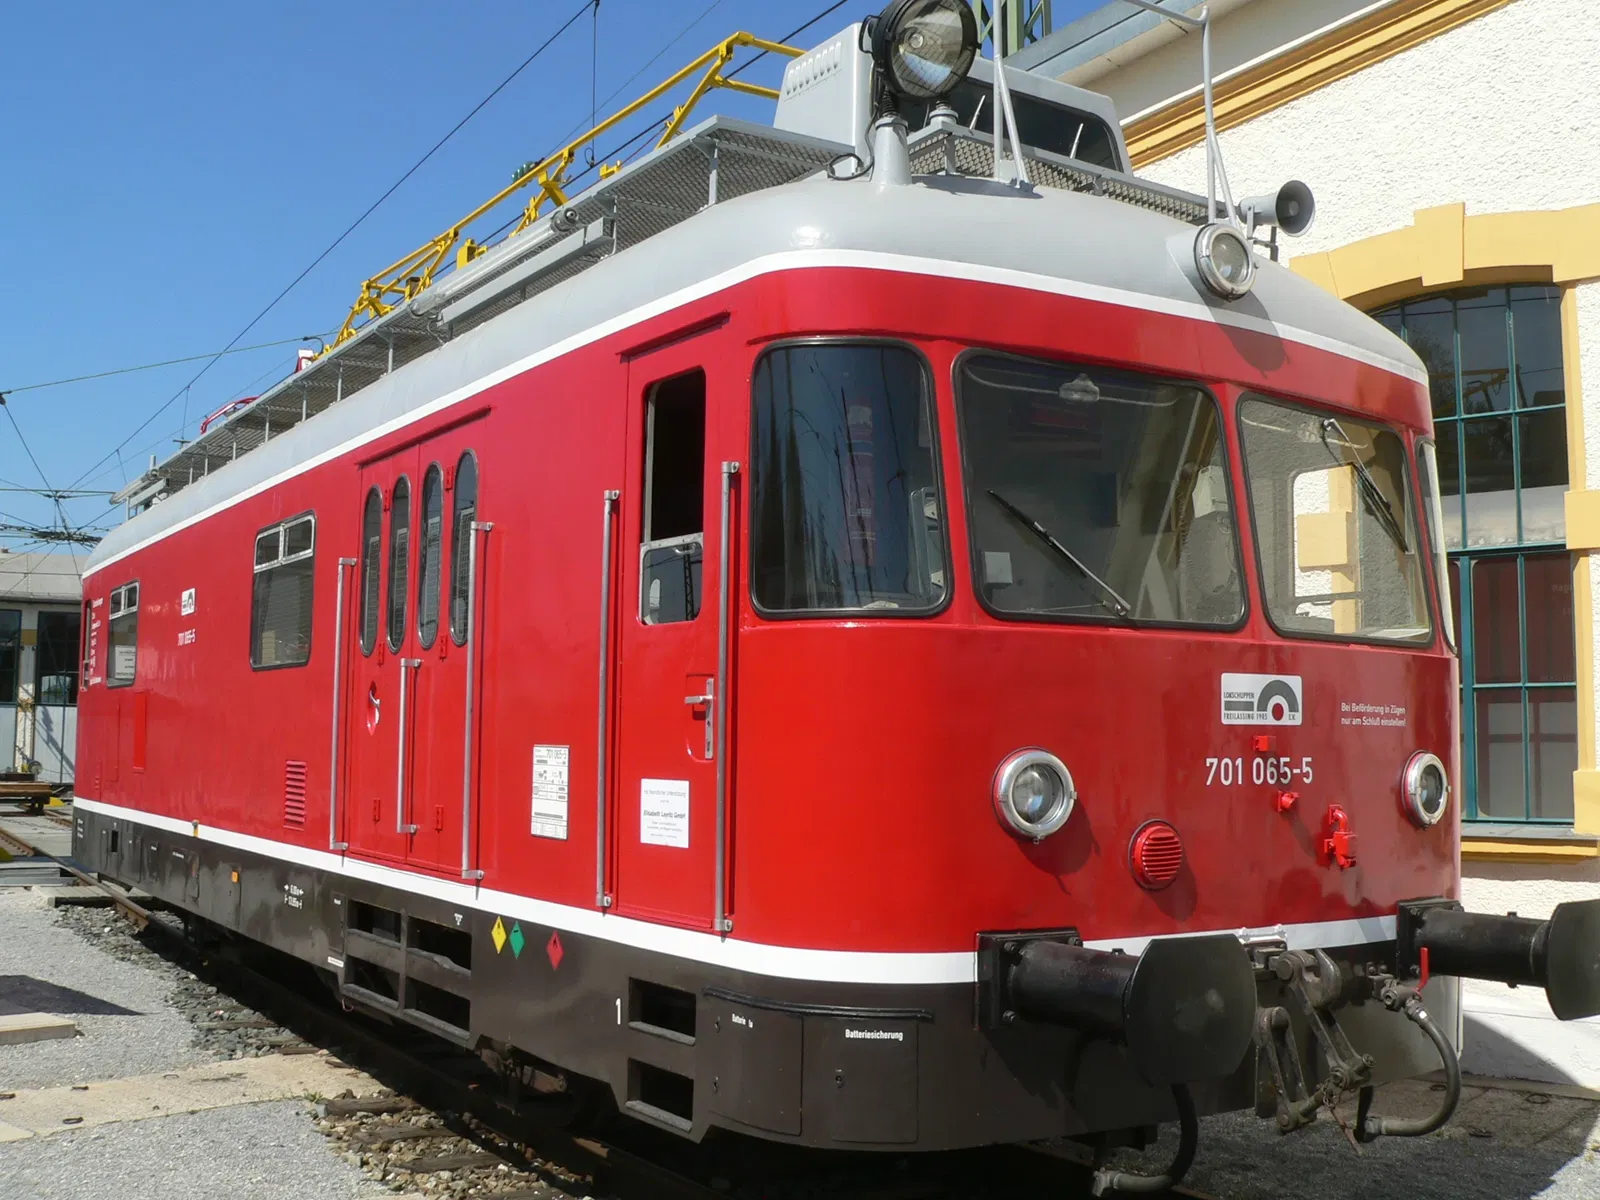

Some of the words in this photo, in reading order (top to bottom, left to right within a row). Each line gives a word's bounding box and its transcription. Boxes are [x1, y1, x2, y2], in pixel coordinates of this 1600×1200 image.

[1223, 691, 1255, 699] LOKSCHUPPEN
[1341, 702, 1351, 712] Bei
[1351, 703, 1384, 715] Beförderung
[1384, 705, 1390, 713] in
[1390, 704, 1406, 716] Zügen
[1223, 712, 1255, 721] FREILASSING
[1341, 717, 1351, 725] nur
[1205, 757, 1243, 786] 701
[1252, 757, 1313, 785] 065-5
[615, 998, 622, 1025] 1
[845, 1028, 904, 1041] Batteriesicherung
